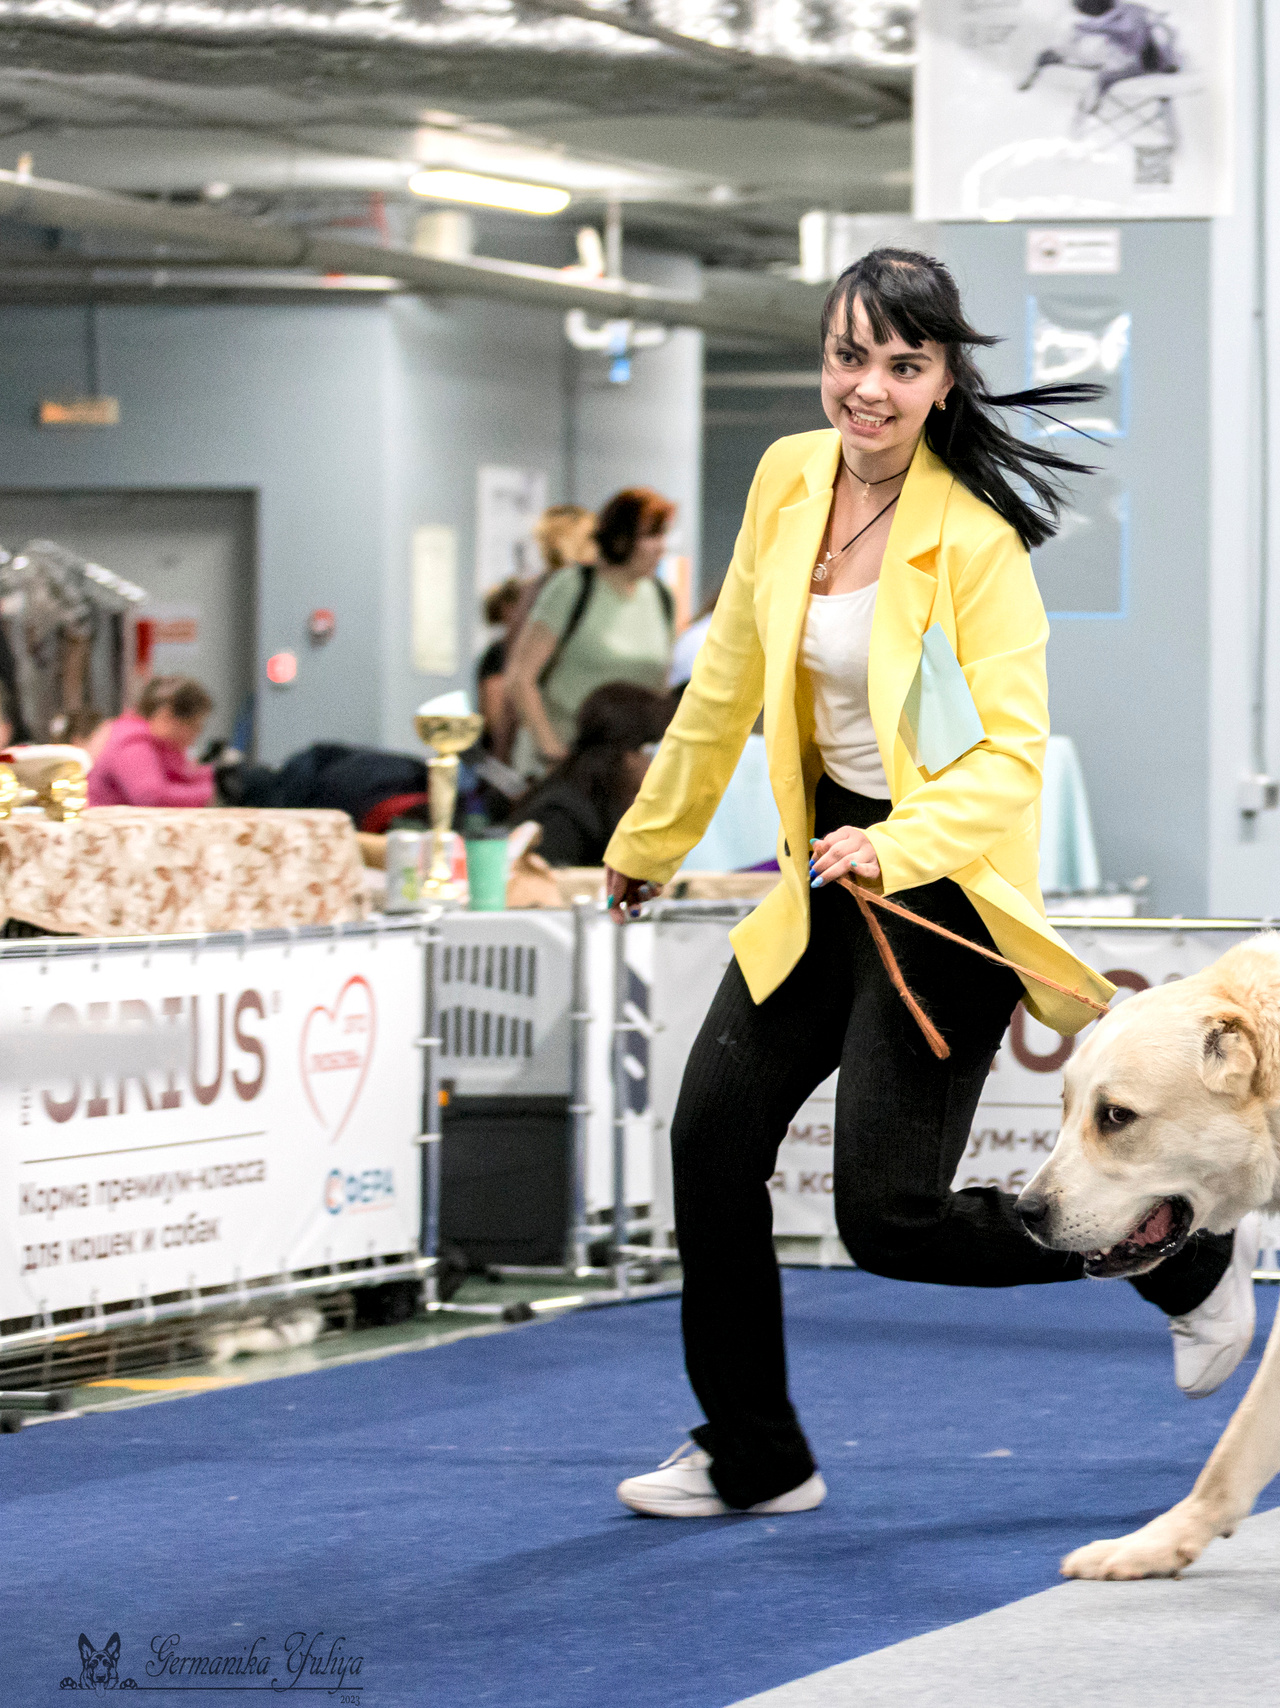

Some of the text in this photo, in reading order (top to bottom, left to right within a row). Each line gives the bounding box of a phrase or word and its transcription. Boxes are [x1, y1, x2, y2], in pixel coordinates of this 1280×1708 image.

[19, 1181, 88, 1220] Корма
[65, 1229, 138, 1266] кошек
[161, 1210, 222, 1249] собак
